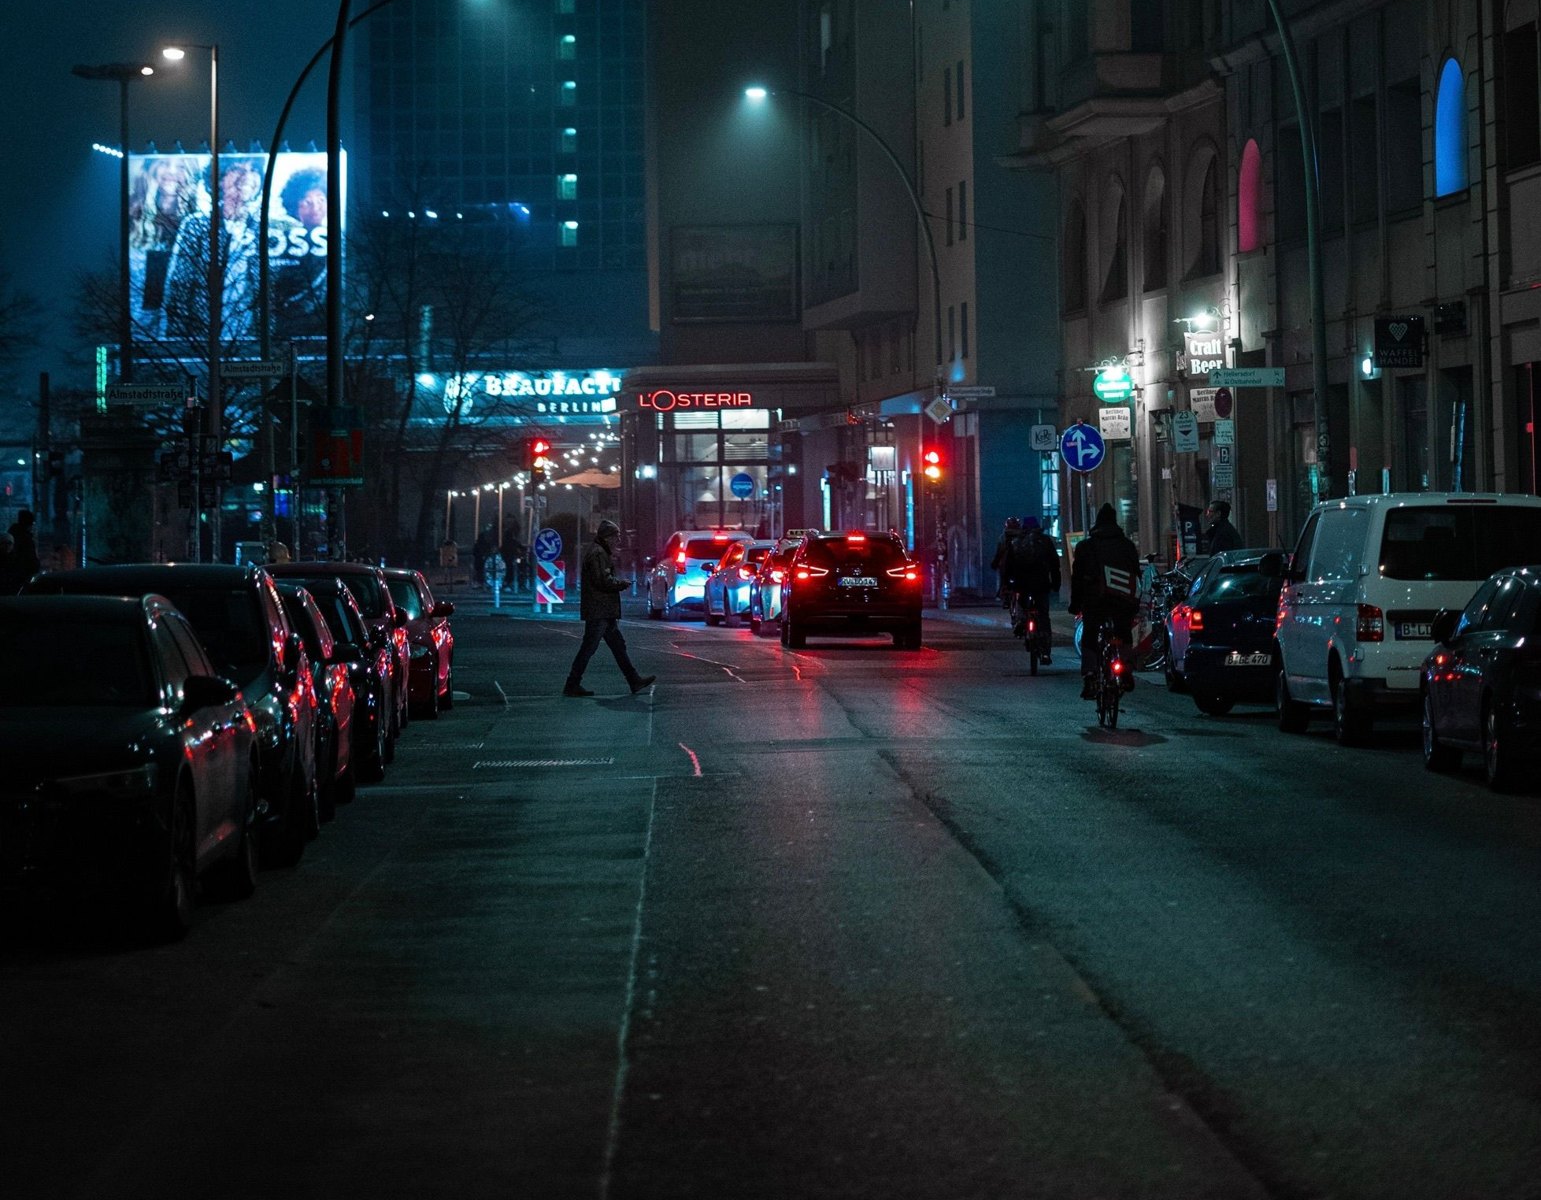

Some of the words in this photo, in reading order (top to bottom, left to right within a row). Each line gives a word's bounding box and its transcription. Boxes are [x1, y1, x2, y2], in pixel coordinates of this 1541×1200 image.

[1189, 338, 1222, 356] Craft
[1379, 348, 1418, 357] WAFFEL
[1190, 358, 1223, 375] Beer
[1379, 356, 1418, 366] HANDEL
[224, 363, 282, 374] Almstadtstraße
[110, 389, 184, 401] Almstadtstraße
[639, 389, 752, 411] L'OSTERIA
[537, 402, 601, 413] BERLIN
[1185, 521, 1193, 533] P
[1403, 624, 1411, 635] B
[1228, 655, 1234, 665] B
[1251, 655, 1268, 665] 470
